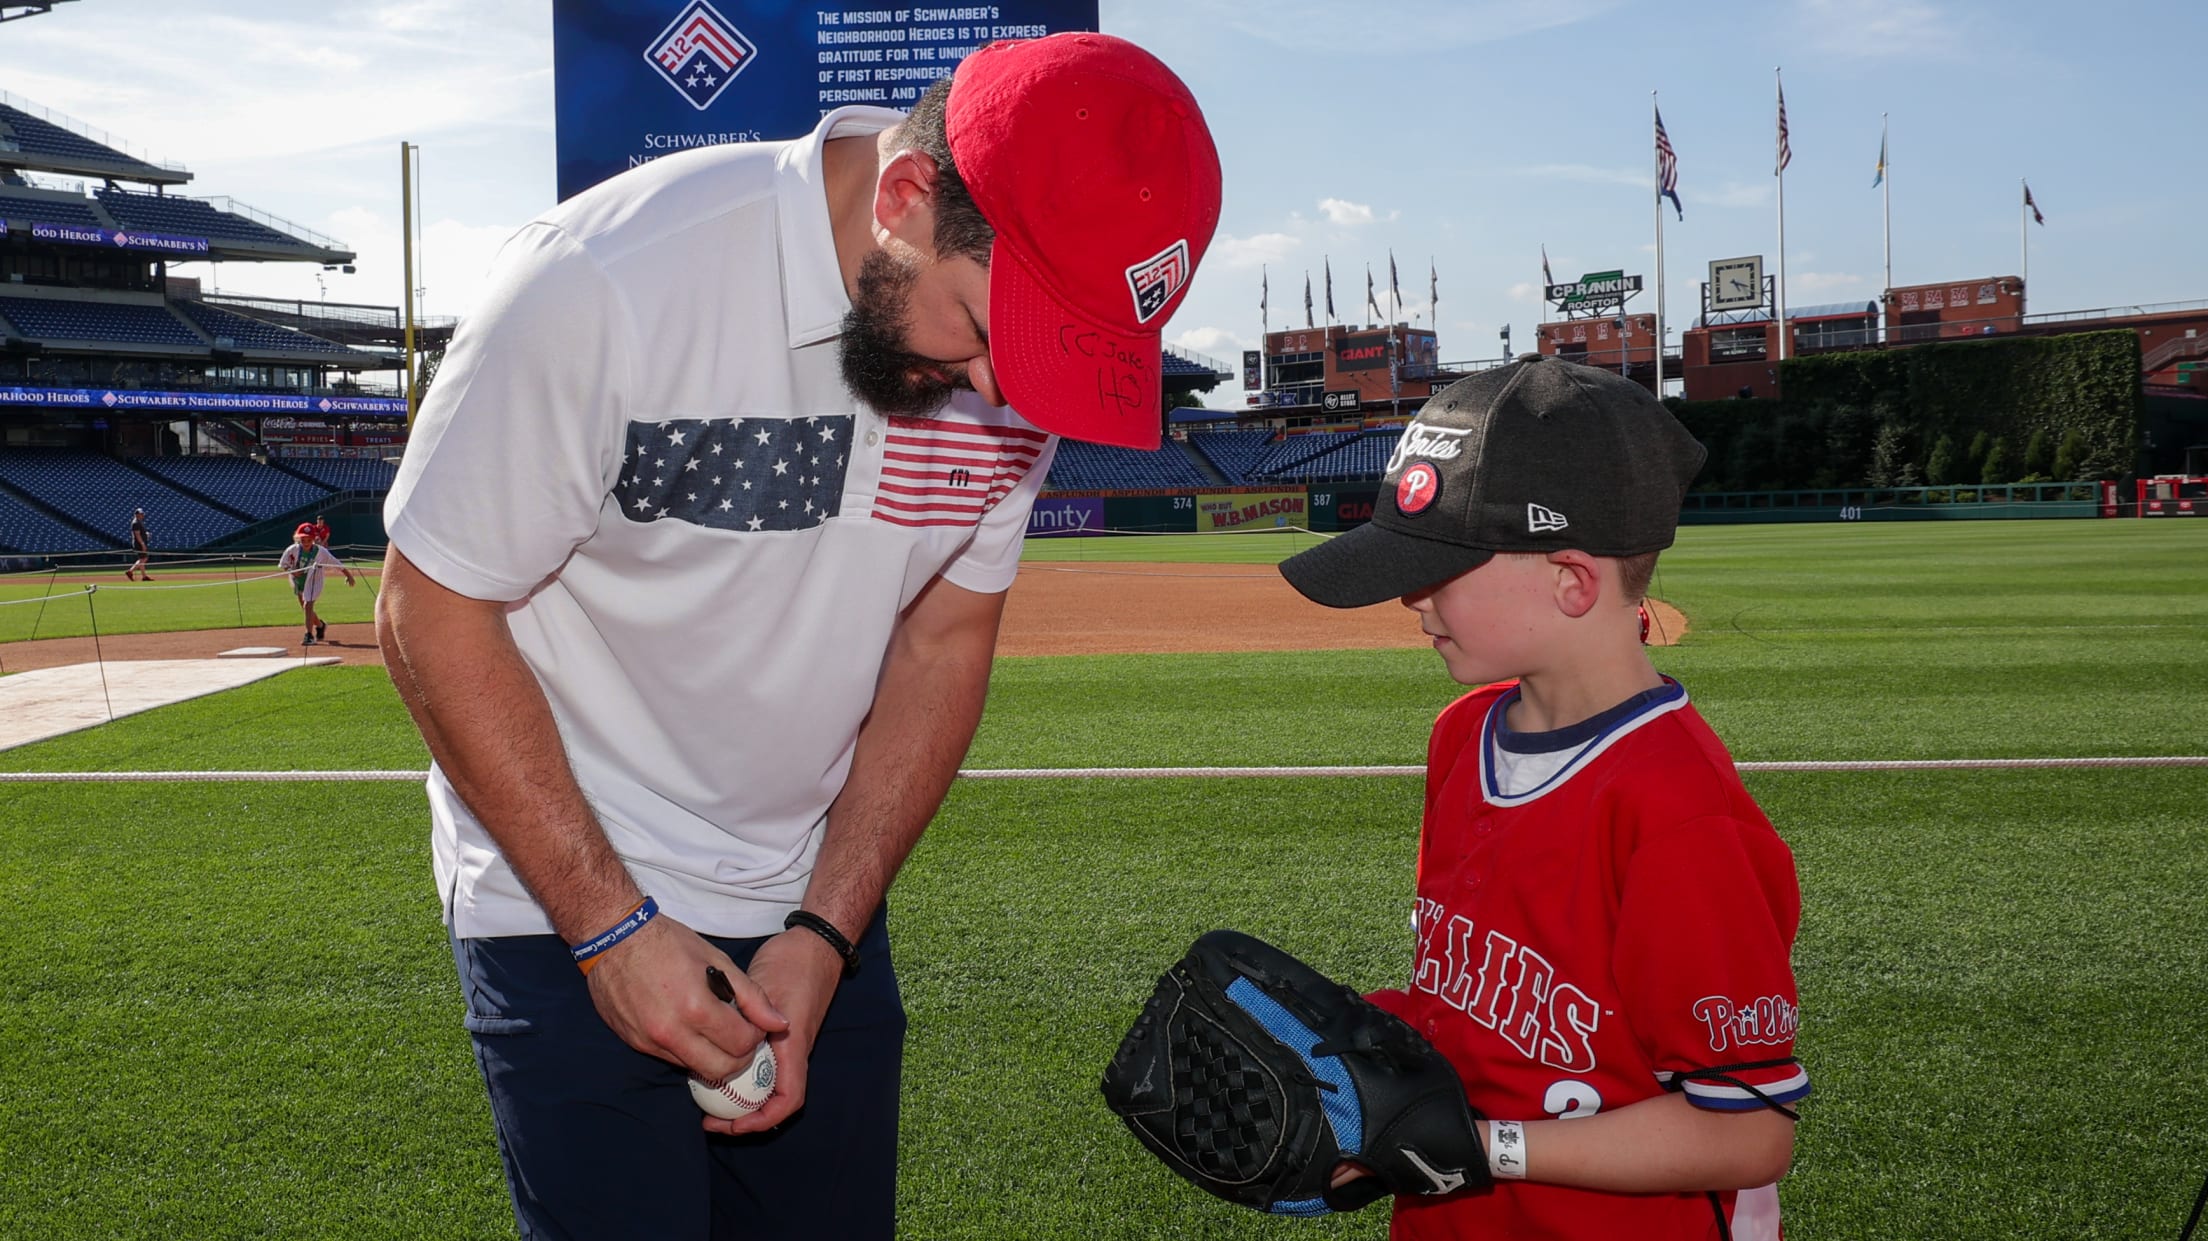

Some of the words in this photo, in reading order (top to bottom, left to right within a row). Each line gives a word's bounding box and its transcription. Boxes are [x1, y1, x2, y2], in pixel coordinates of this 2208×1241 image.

[843, 10, 891, 24] MISSION
[895, 9, 911, 22] OF
[914, 5, 999, 22] SCHWARBER'S
[817, 29, 905, 44] NEIGHBORHOOD
[909, 27, 955, 41] HEROES
[958, 27, 970, 40] IS
[973, 26, 988, 39] TO
[992, 24, 1047, 38] EXPRESS
[818, 49, 883, 63] GRATITUDE
[886, 48, 909, 61] FOR
[912, 48, 935, 60] THE
[818, 70, 834, 83] OF
[838, 69, 872, 82] FIRST
[819, 88, 888, 102] PERSONNEL
[891, 87, 916, 100] AND
[1552, 286, 1574, 297] CP
[1576, 277, 1634, 297] RANKIN
[1567, 298, 1619, 310] ROOFTOP
[1341, 346, 1384, 361] GIANT
[1173, 498, 1192, 509] 374
[1314, 494, 1331, 506] 387
[1840, 506, 1861, 520] 401
